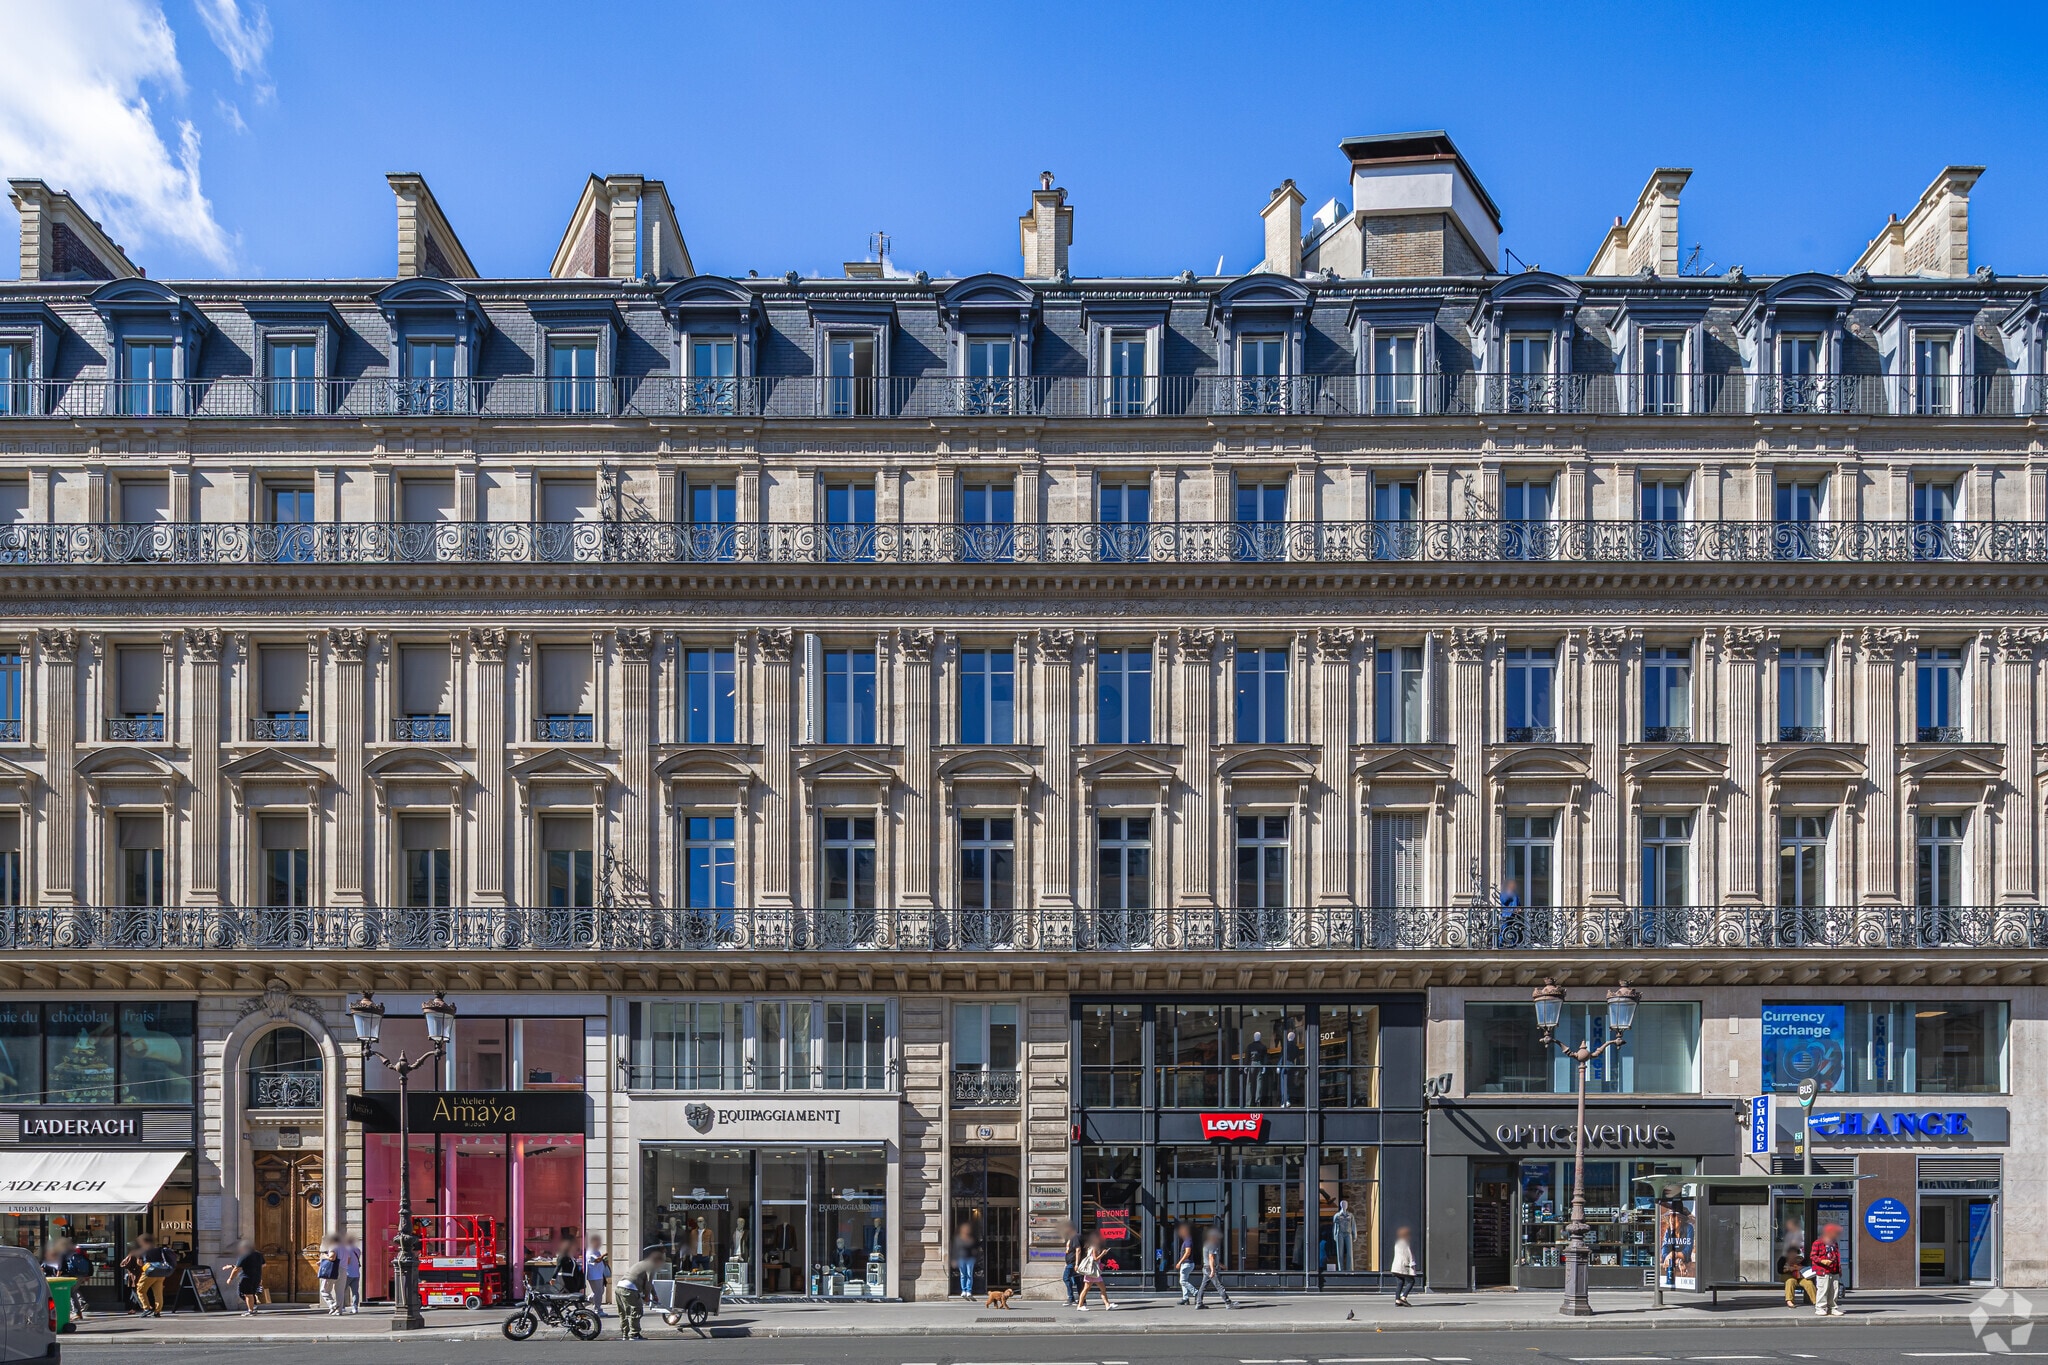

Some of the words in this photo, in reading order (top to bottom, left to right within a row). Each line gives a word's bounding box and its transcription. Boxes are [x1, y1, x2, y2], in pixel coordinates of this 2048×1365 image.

[21, 1010, 38, 1022] du
[51, 1010, 109, 1022] chocolat
[124, 1010, 154, 1022] frais
[1763, 1011, 1825, 1024] Currency
[1763, 1025, 1831, 1038] Exchange
[1593, 1017, 1603, 1079] CHAGE
[1876, 1016, 1885, 1078] CHANGE
[1800, 1085, 1812, 1095] BUS
[433, 1097, 516, 1123] Amaya
[718, 1109, 841, 1125] EQUIPAGGIAMENTI
[24, 1119, 134, 1134] LÄDERACH
[1756, 1098, 1768, 1151] CHANGE
[0, 1180, 106, 1191] ÄDERACH
[669, 1203, 729, 1211] EQUIPAGGIAMENTI
[1664, 1237, 1691, 1245] SAUVAGE
